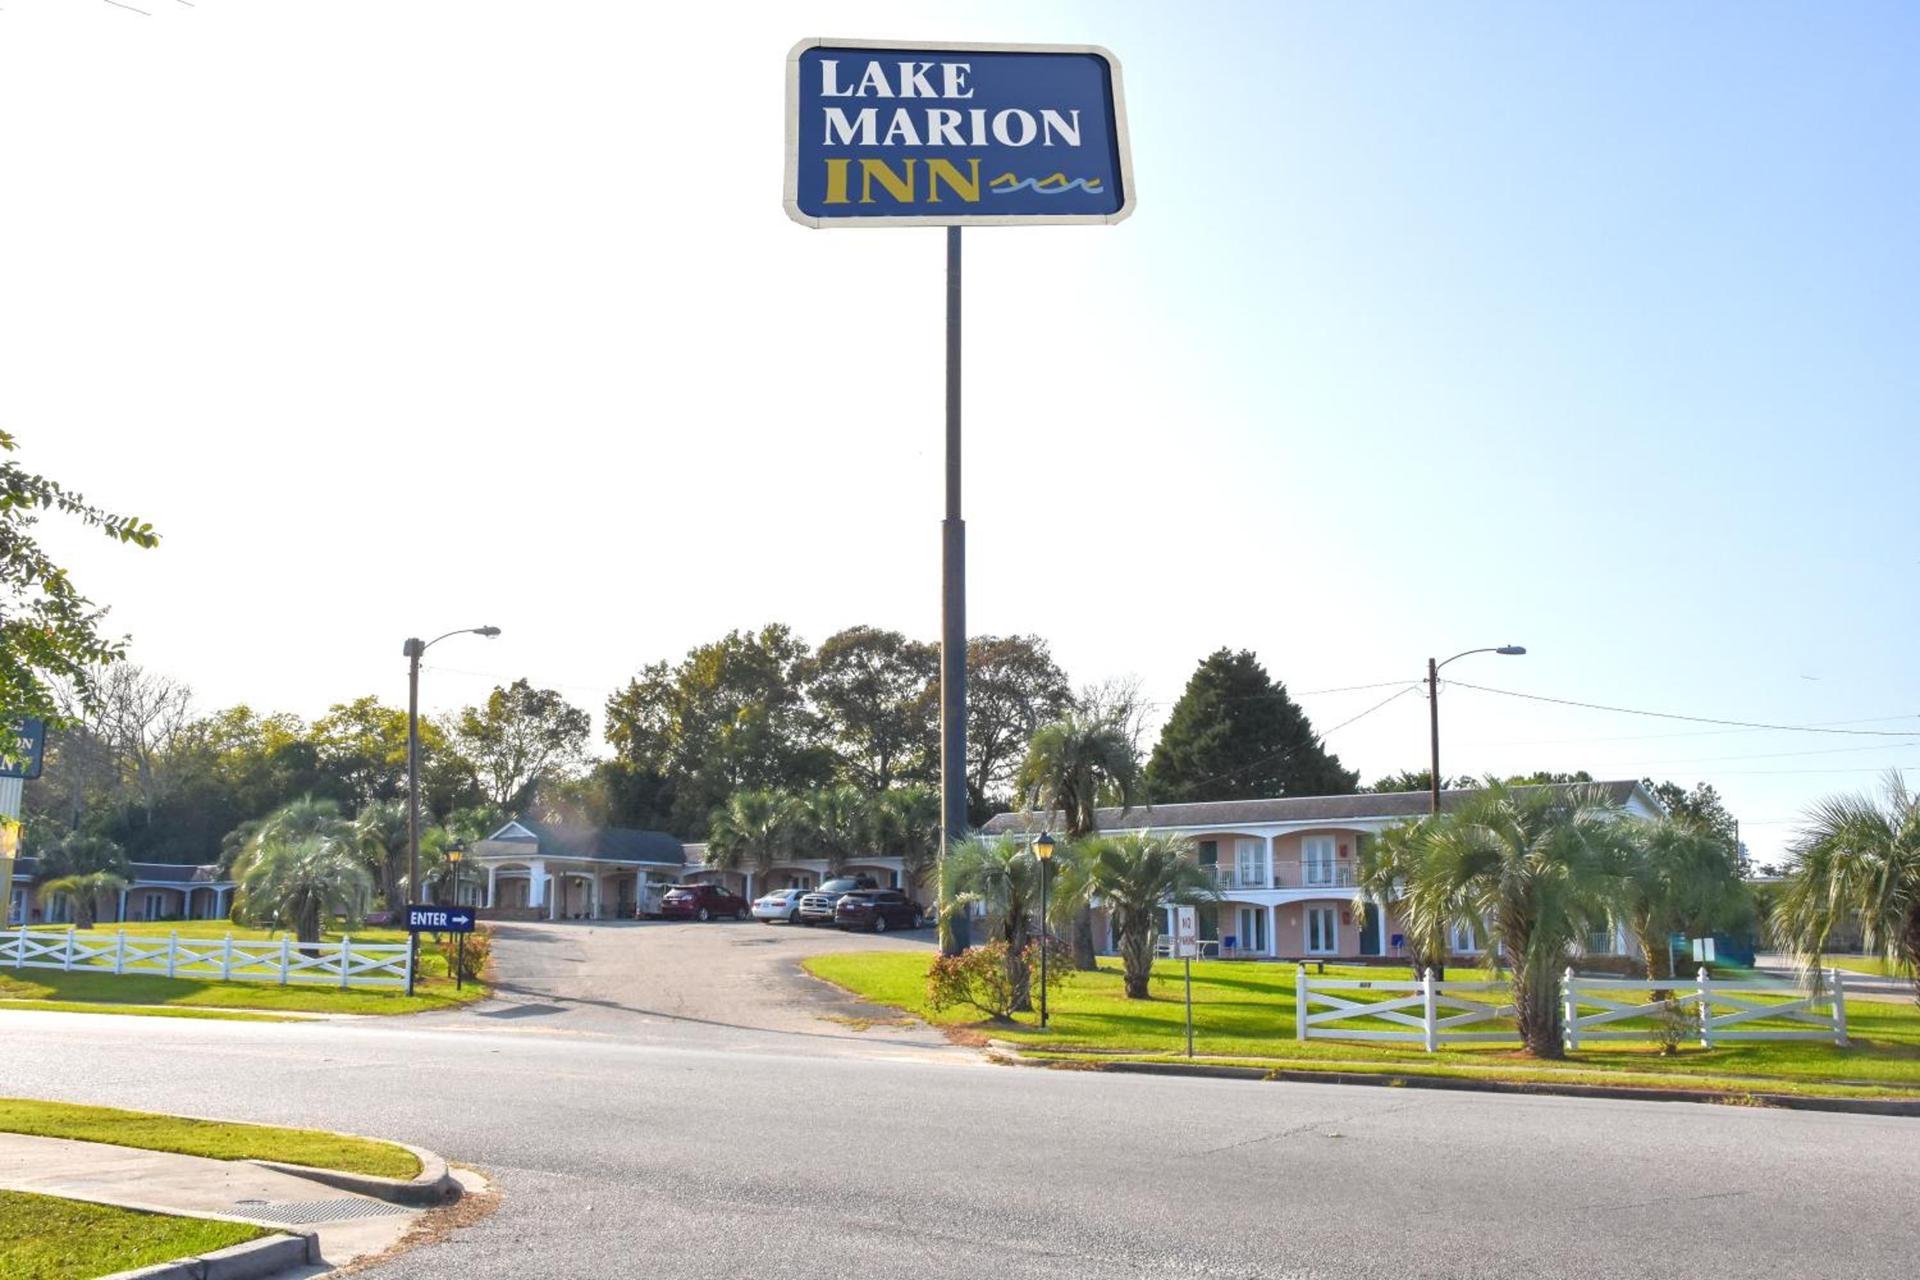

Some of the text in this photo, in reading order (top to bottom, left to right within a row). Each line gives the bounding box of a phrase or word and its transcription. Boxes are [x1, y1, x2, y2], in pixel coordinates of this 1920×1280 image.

[819, 59, 975, 99] LAKE
[822, 107, 1082, 147] MARION
[822, 157, 982, 204] INN
[410, 911, 448, 926] ENTER
